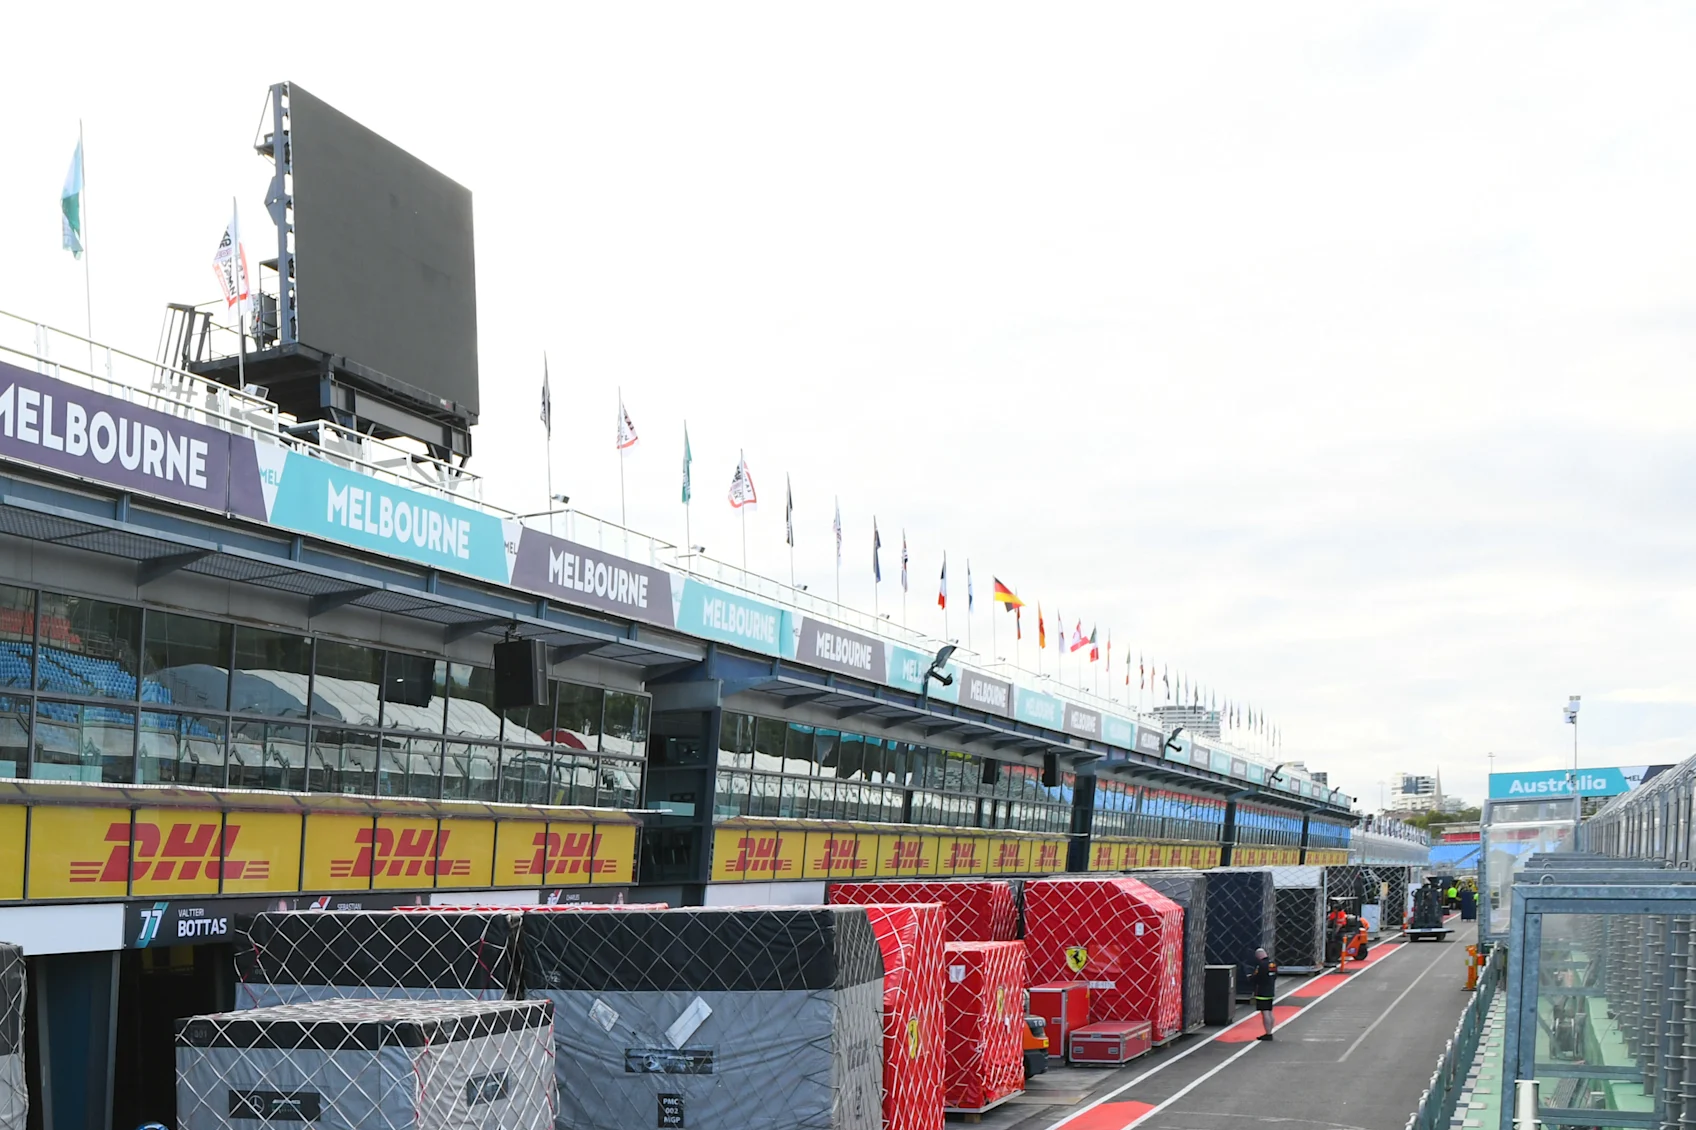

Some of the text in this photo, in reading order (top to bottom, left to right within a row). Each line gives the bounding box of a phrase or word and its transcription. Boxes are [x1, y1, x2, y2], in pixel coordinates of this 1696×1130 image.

[327, 478, 471, 560] MELBOURNE
[548, 545, 648, 609] MELBOURNE
[703, 596, 776, 645] MELBOURNE
[816, 629, 872, 671] MELBOURNE
[1509, 775, 1607, 794] Australia
[103, 822, 246, 882] DHL
[352, 828, 455, 877] DHL
[532, 832, 606, 875] DHL
[735, 838, 784, 872] DHL
[822, 839, 861, 870] DHL
[892, 841, 924, 869] DHL
[138, 909, 165, 940] 77
[178, 909, 205, 917] VALTTERI
[178, 917, 228, 938] BOTTAS
